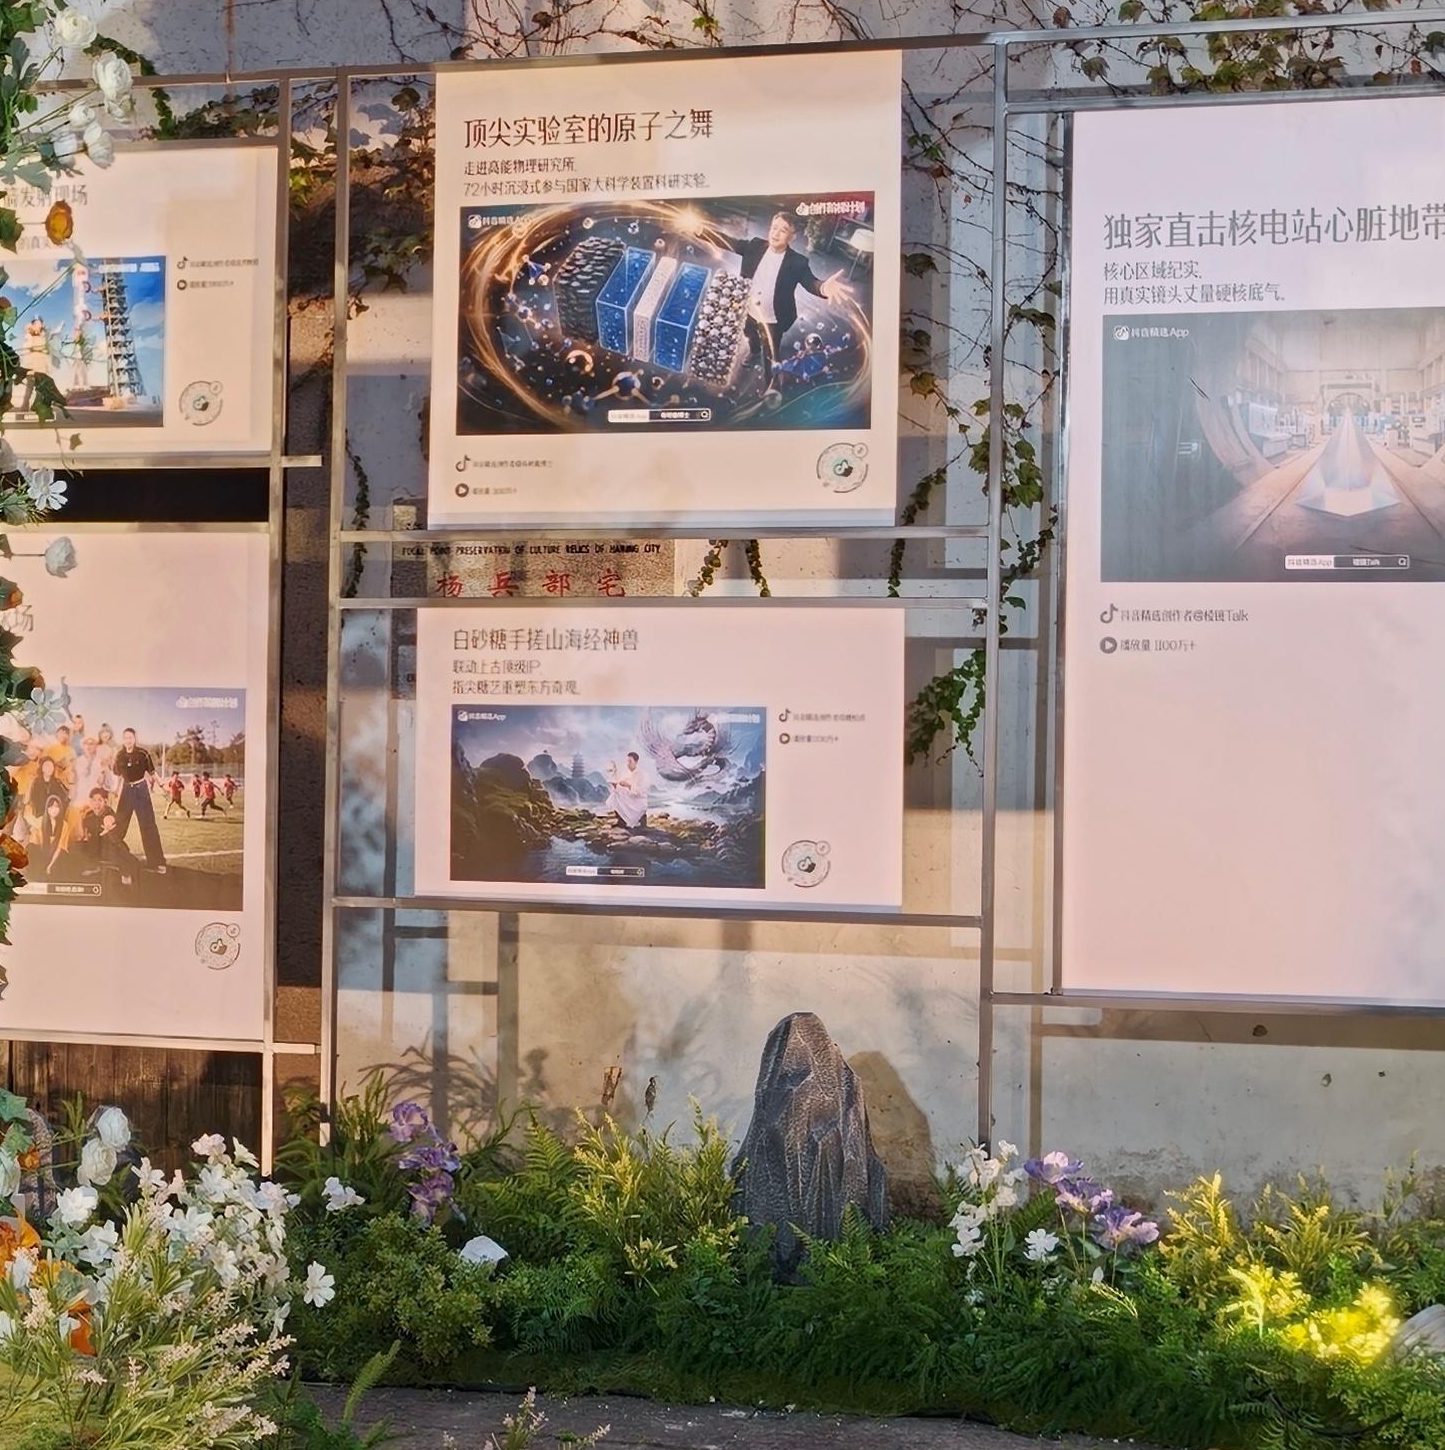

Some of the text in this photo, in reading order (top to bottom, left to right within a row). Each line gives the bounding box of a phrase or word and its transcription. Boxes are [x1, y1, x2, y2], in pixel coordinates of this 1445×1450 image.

[463, 108, 713, 149] 顶尖实验室的原子之舞
[453, 627, 639, 651] 白砂糖手搓山海经神兽
